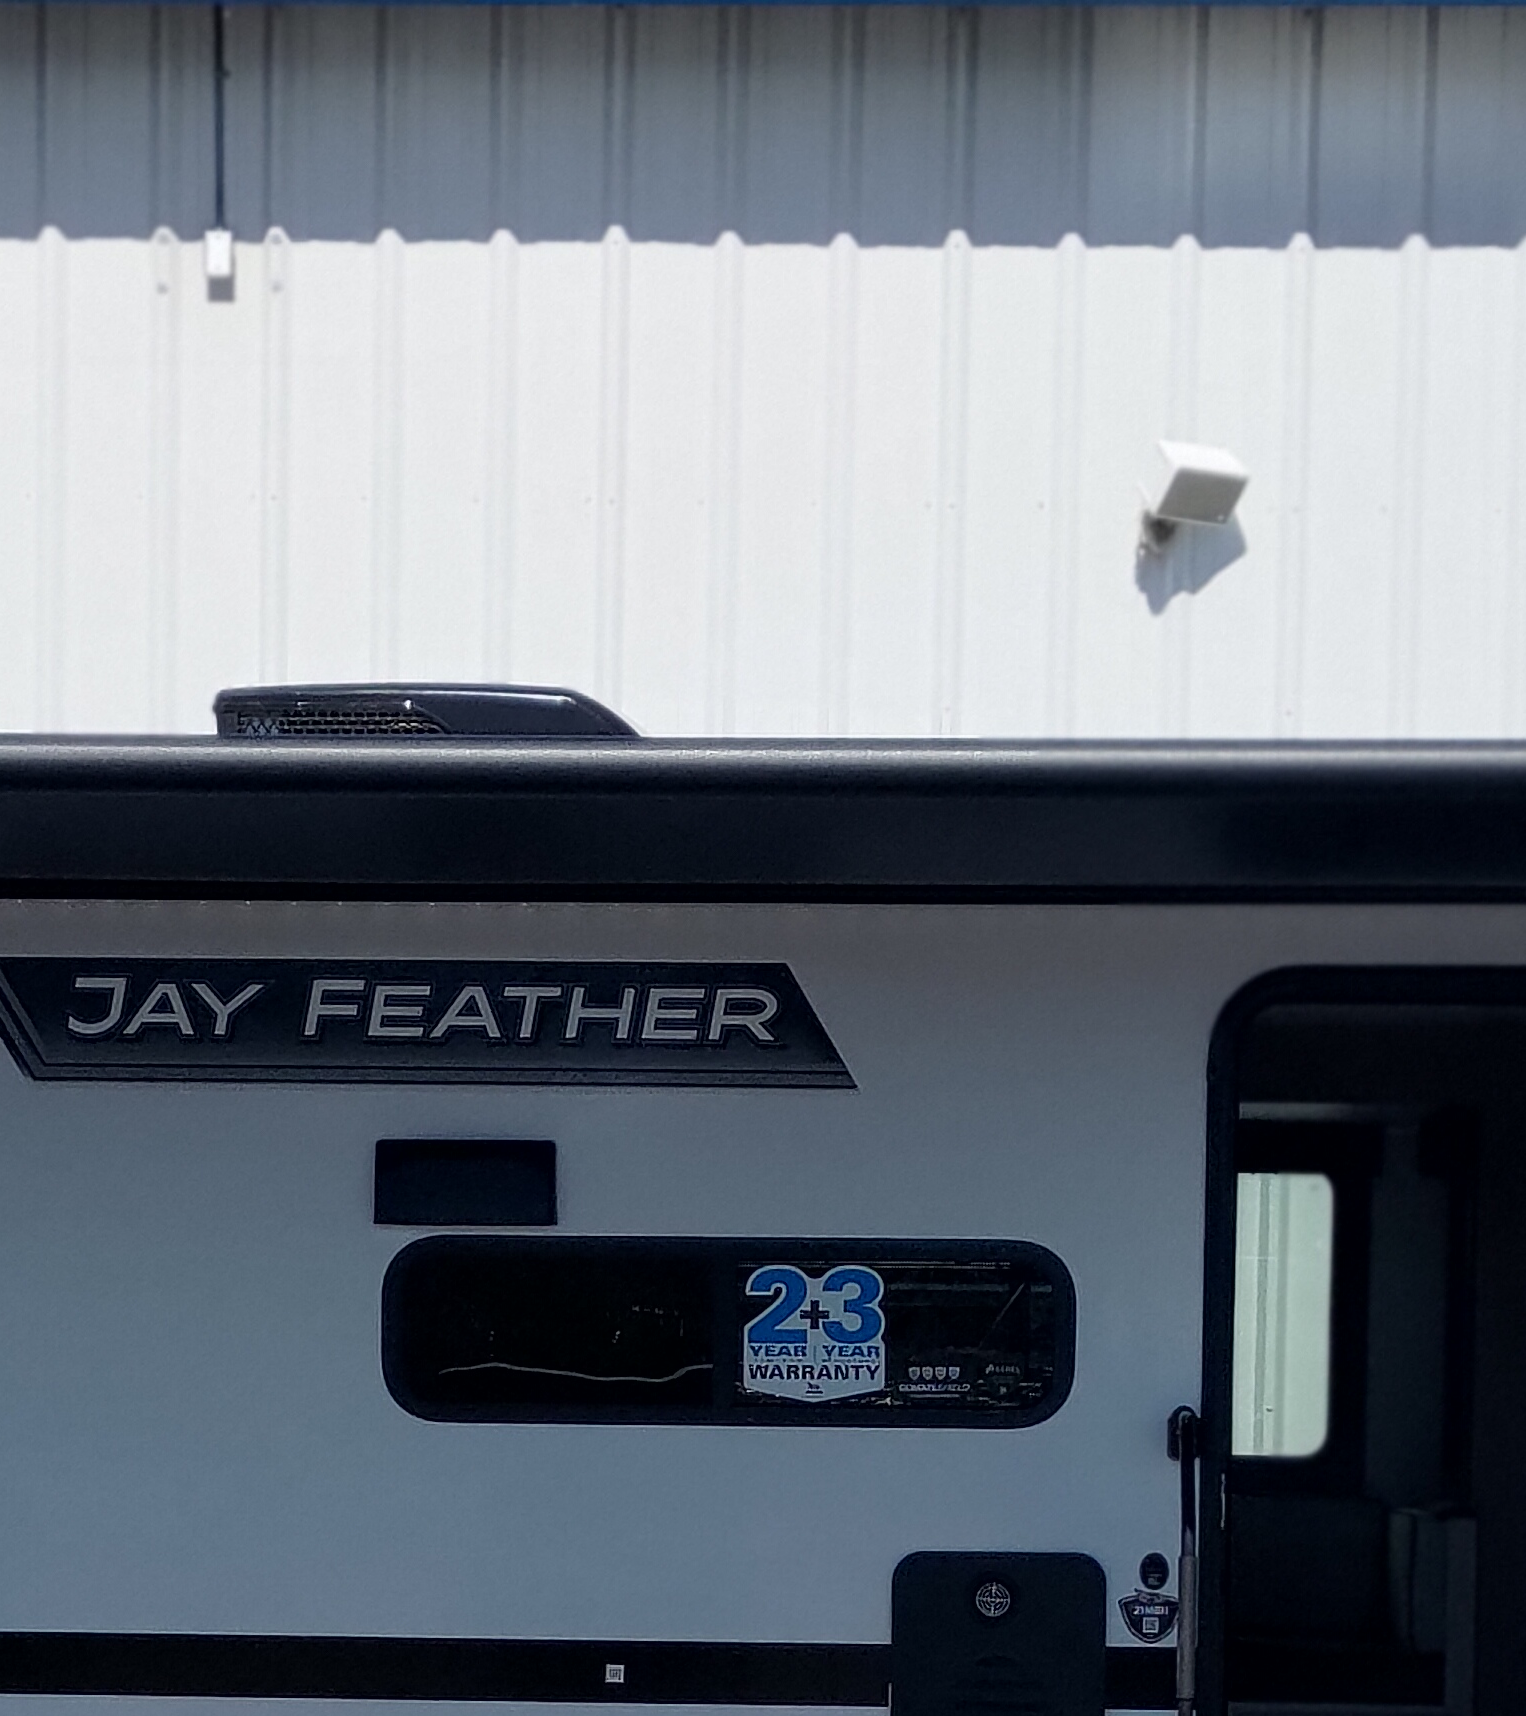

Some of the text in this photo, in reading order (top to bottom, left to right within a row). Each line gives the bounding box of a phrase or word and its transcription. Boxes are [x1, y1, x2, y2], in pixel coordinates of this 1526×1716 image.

[67, 976, 779, 1043] JAY FEATHER
[749, 1344, 880, 1359] YEAR YEAR
[748, 1364, 880, 1381] WARRANTY
